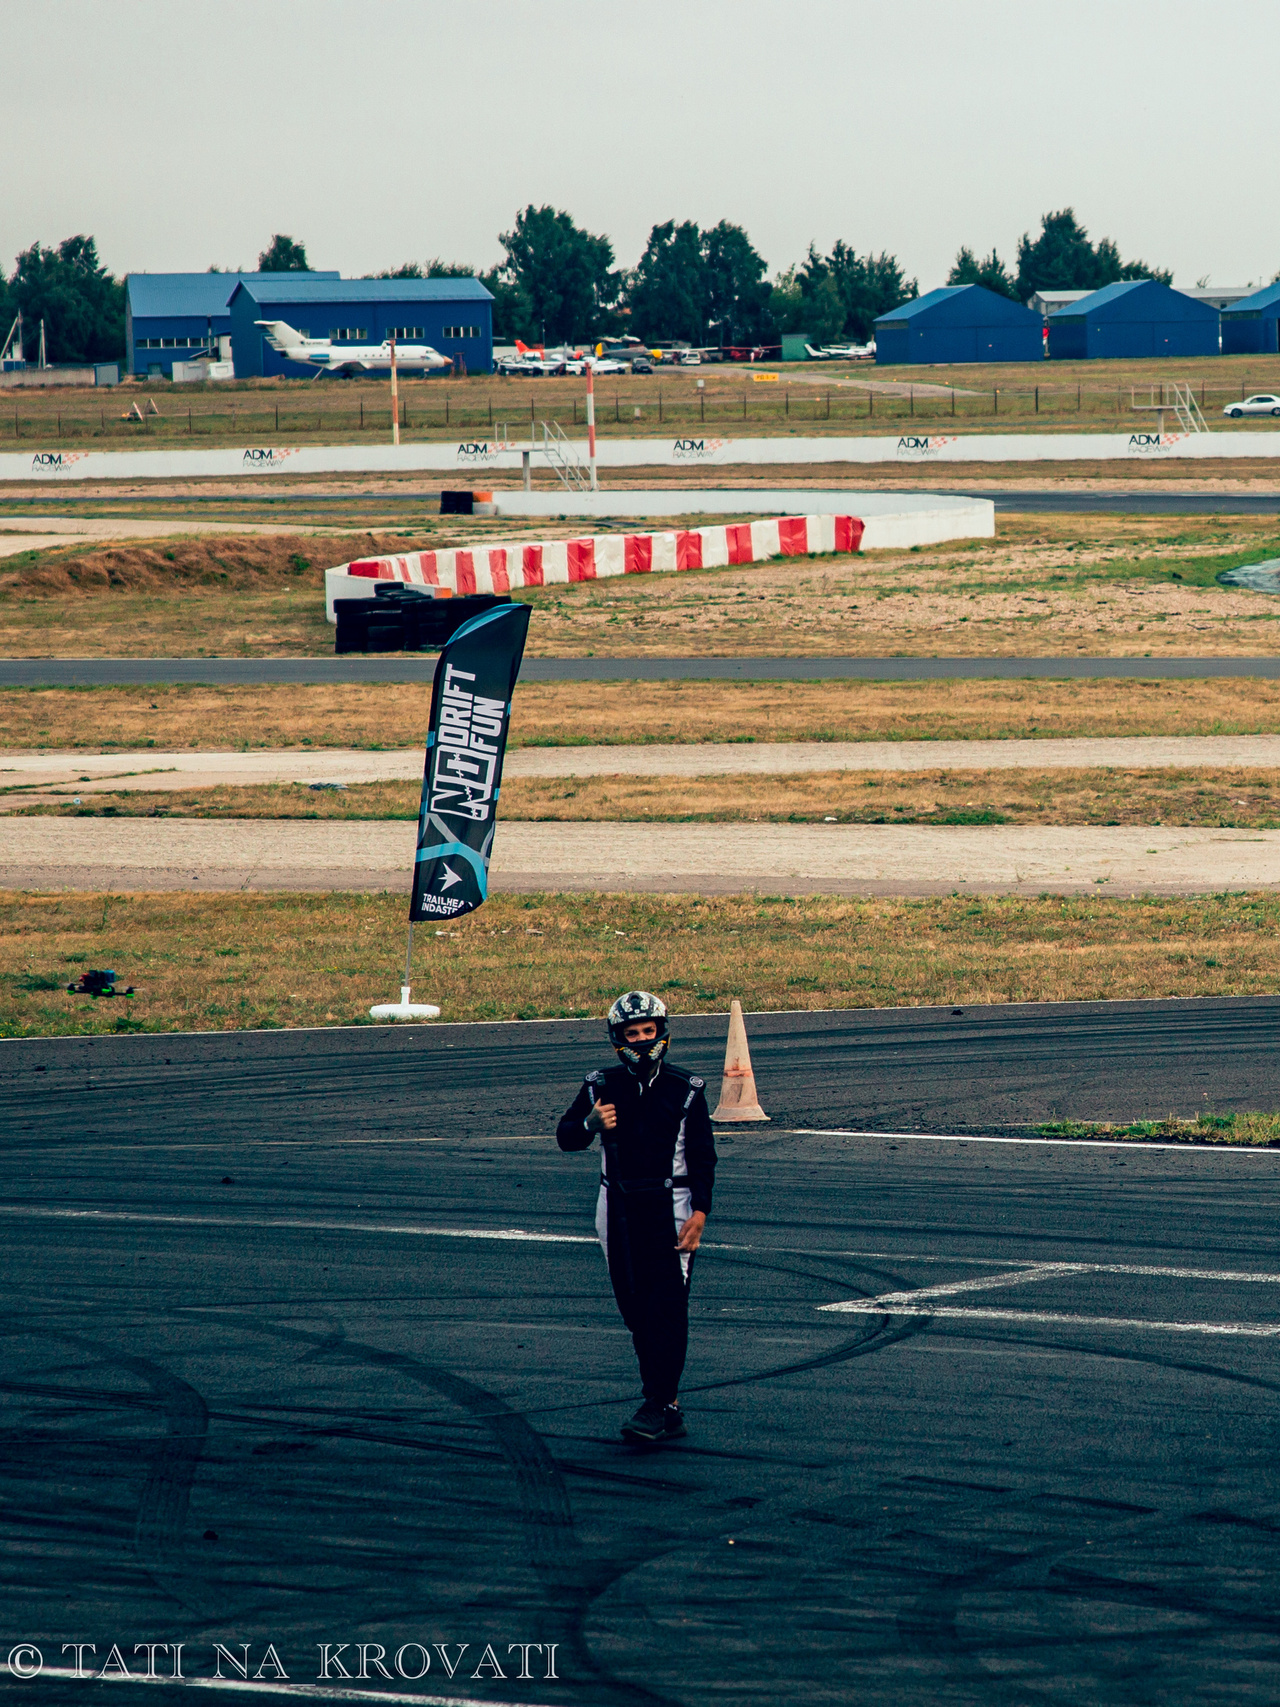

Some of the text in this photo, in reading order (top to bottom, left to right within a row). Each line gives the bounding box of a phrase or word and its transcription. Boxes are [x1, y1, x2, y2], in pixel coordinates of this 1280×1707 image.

[897, 437, 929, 448] ADM
[1128, 434, 1160, 445] ADM
[457, 443, 487, 454] ADM
[673, 440, 704, 451] ADM
[1127, 444, 1172, 453] RACEWAY
[243, 449, 273, 460] ADM
[672, 450, 716, 459] RACEWAY
[896, 447, 939, 456] RACEWAY
[32, 453, 62, 465] ADM
[242, 459, 284, 468] RACEWAY
[438, 663, 476, 746] DRIFT
[469, 695, 505, 754] FUN
[423, 893, 473, 909] TRAILHEA
